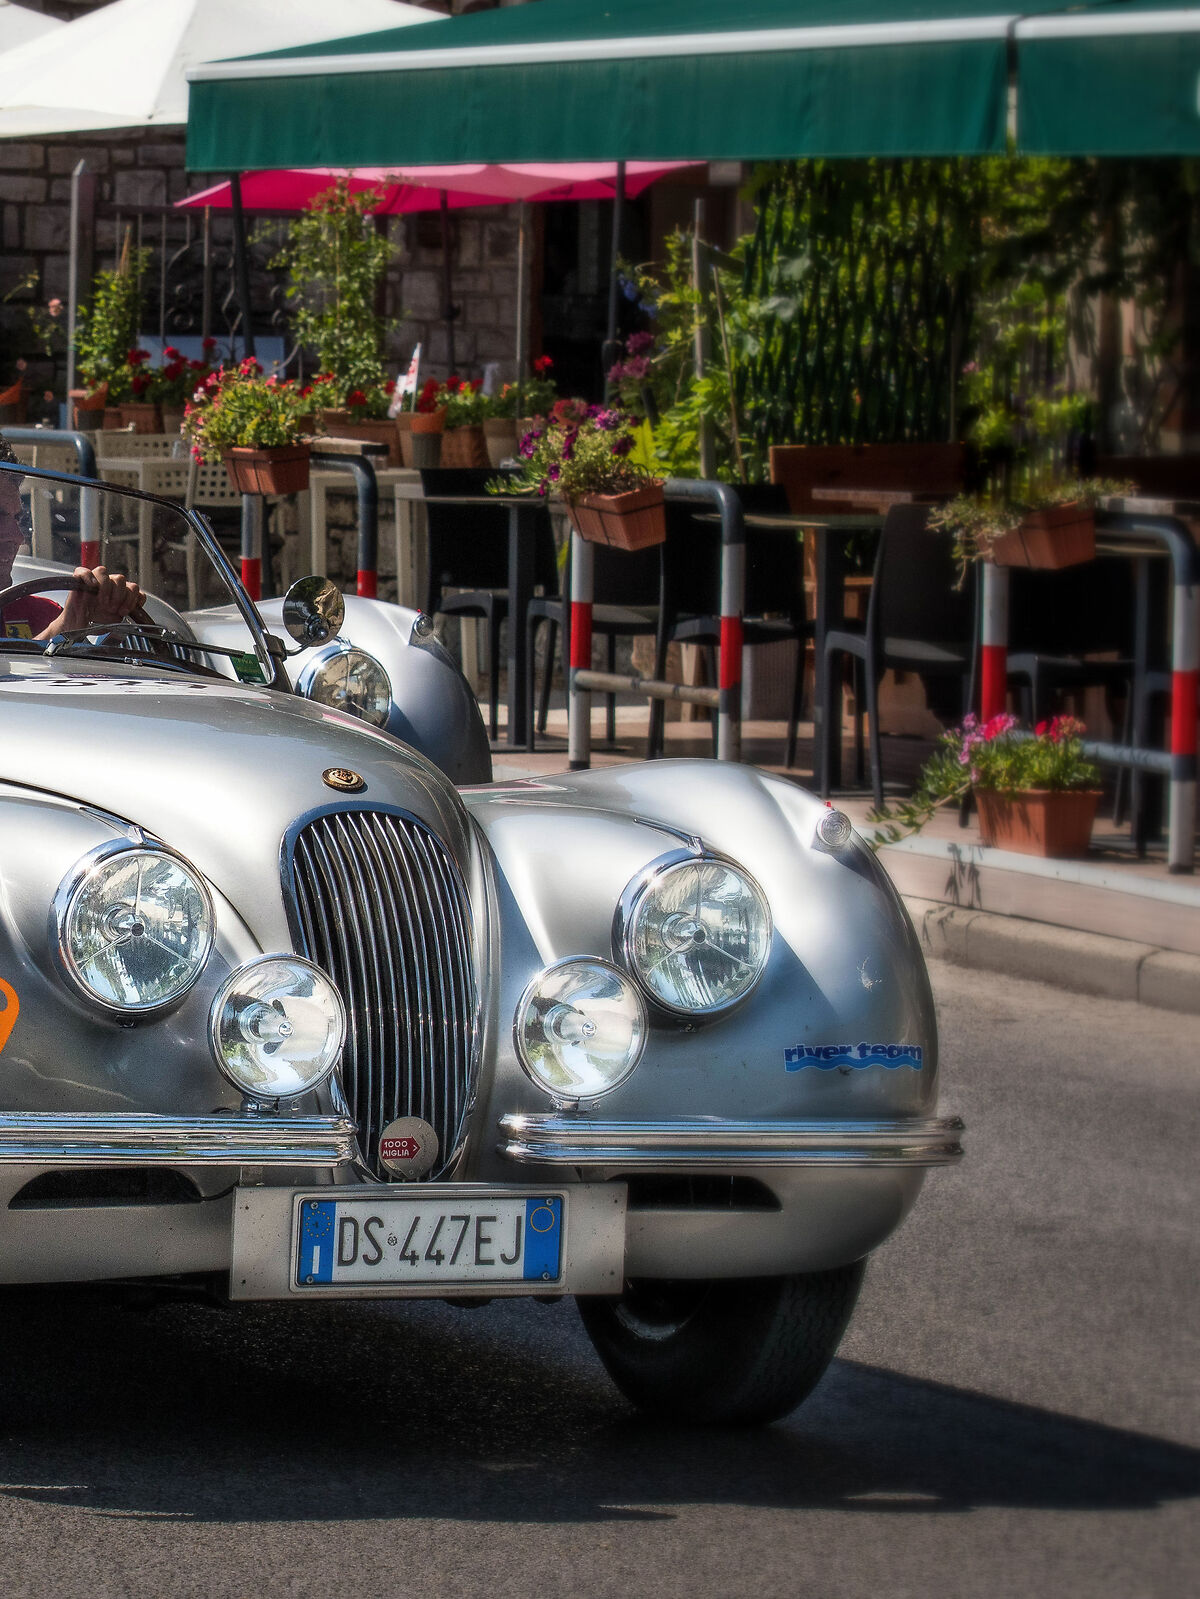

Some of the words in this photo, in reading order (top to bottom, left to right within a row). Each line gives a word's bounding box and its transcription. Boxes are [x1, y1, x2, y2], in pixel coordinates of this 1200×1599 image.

[784, 1043, 852, 1062] river
[857, 1042, 922, 1061] team
[382, 1149, 410, 1157] MIGLIA
